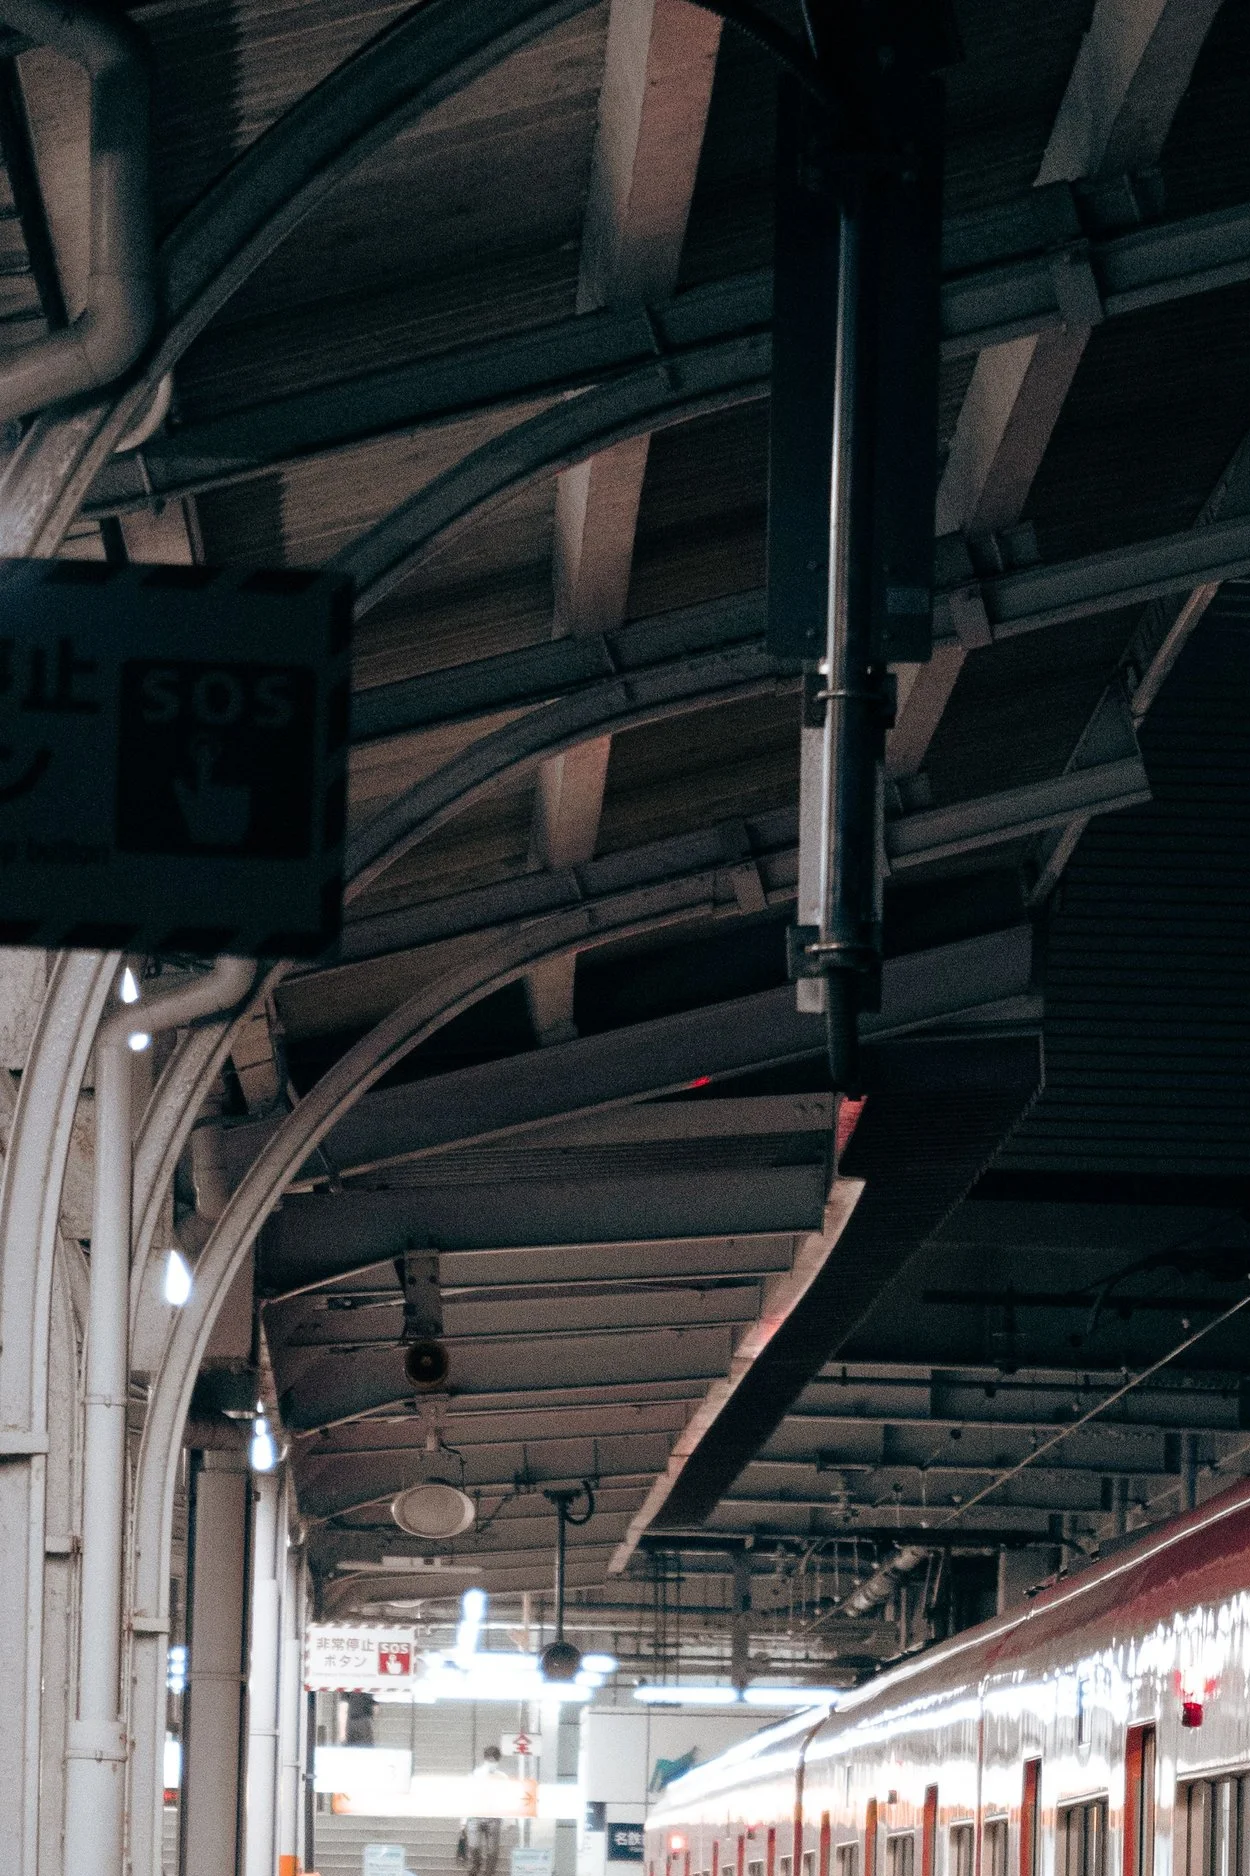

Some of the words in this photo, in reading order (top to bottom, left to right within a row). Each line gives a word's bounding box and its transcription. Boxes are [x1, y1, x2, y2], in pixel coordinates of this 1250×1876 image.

[0, 636, 99, 714] 止
[141, 669, 292, 729] SOS
[316, 1637, 375, 1651] 非常停止
[380, 1643, 409, 1653] SOS
[324, 1654, 367, 1668] ボタン
